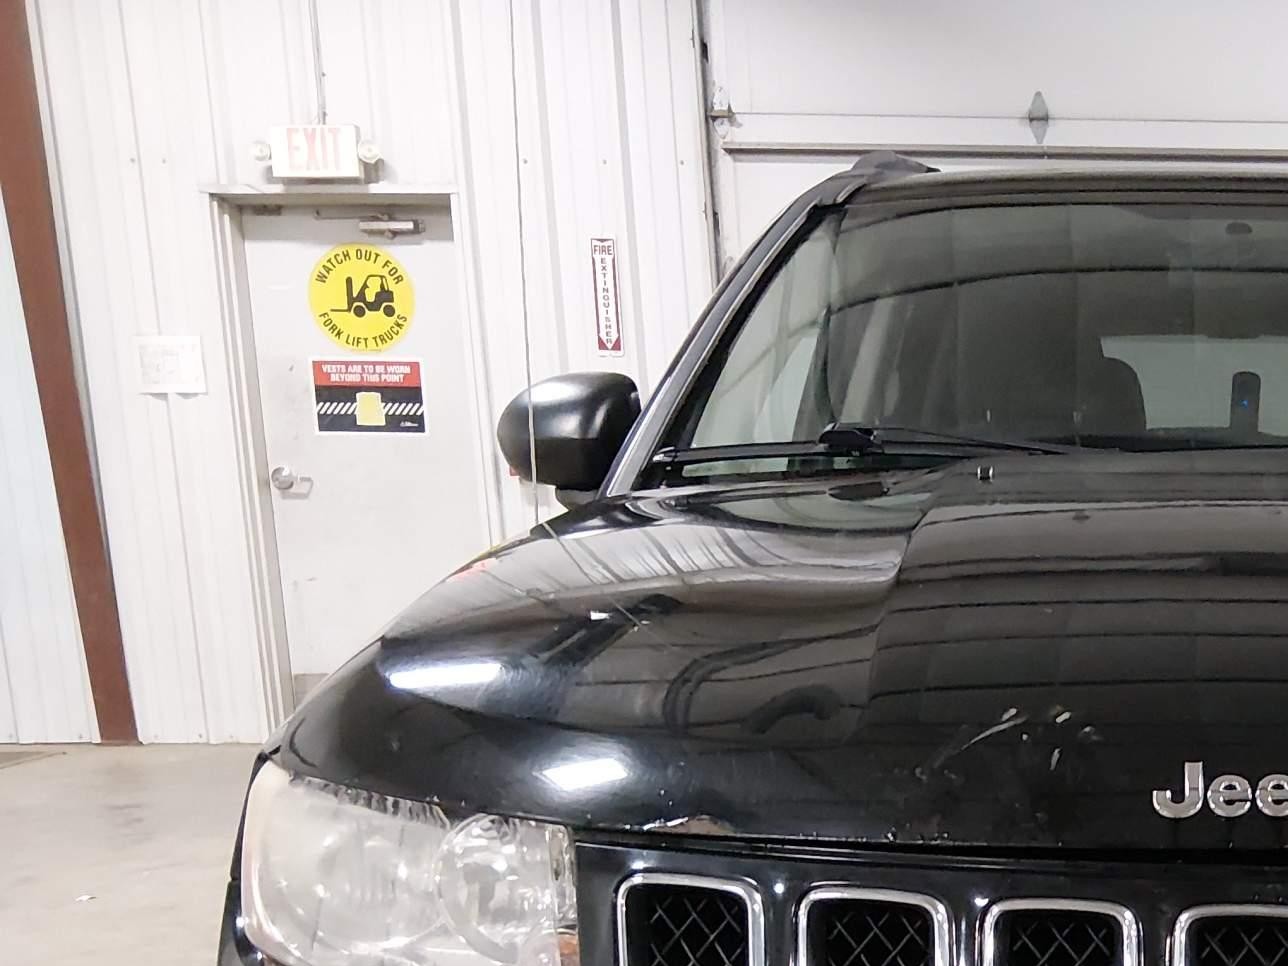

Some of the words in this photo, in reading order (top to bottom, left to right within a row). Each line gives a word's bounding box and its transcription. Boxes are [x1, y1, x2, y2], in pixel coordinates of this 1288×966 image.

[286, 127, 340, 171] EXIT
[315, 249, 351, 284] WATCH
[355, 248, 381, 264] OUT
[382, 259, 404, 285] FOR
[593, 244, 613, 256] FIRE
[600, 257, 613, 345] EXTINGUISHER
[318, 312, 344, 340] FORK
[345, 333, 368, 348] LIFT
[372, 313, 408, 348] TRUCKS
[347, 365, 362, 373] ARE
[363, 365, 373, 374] TO
[381, 374, 404, 383] POINT
